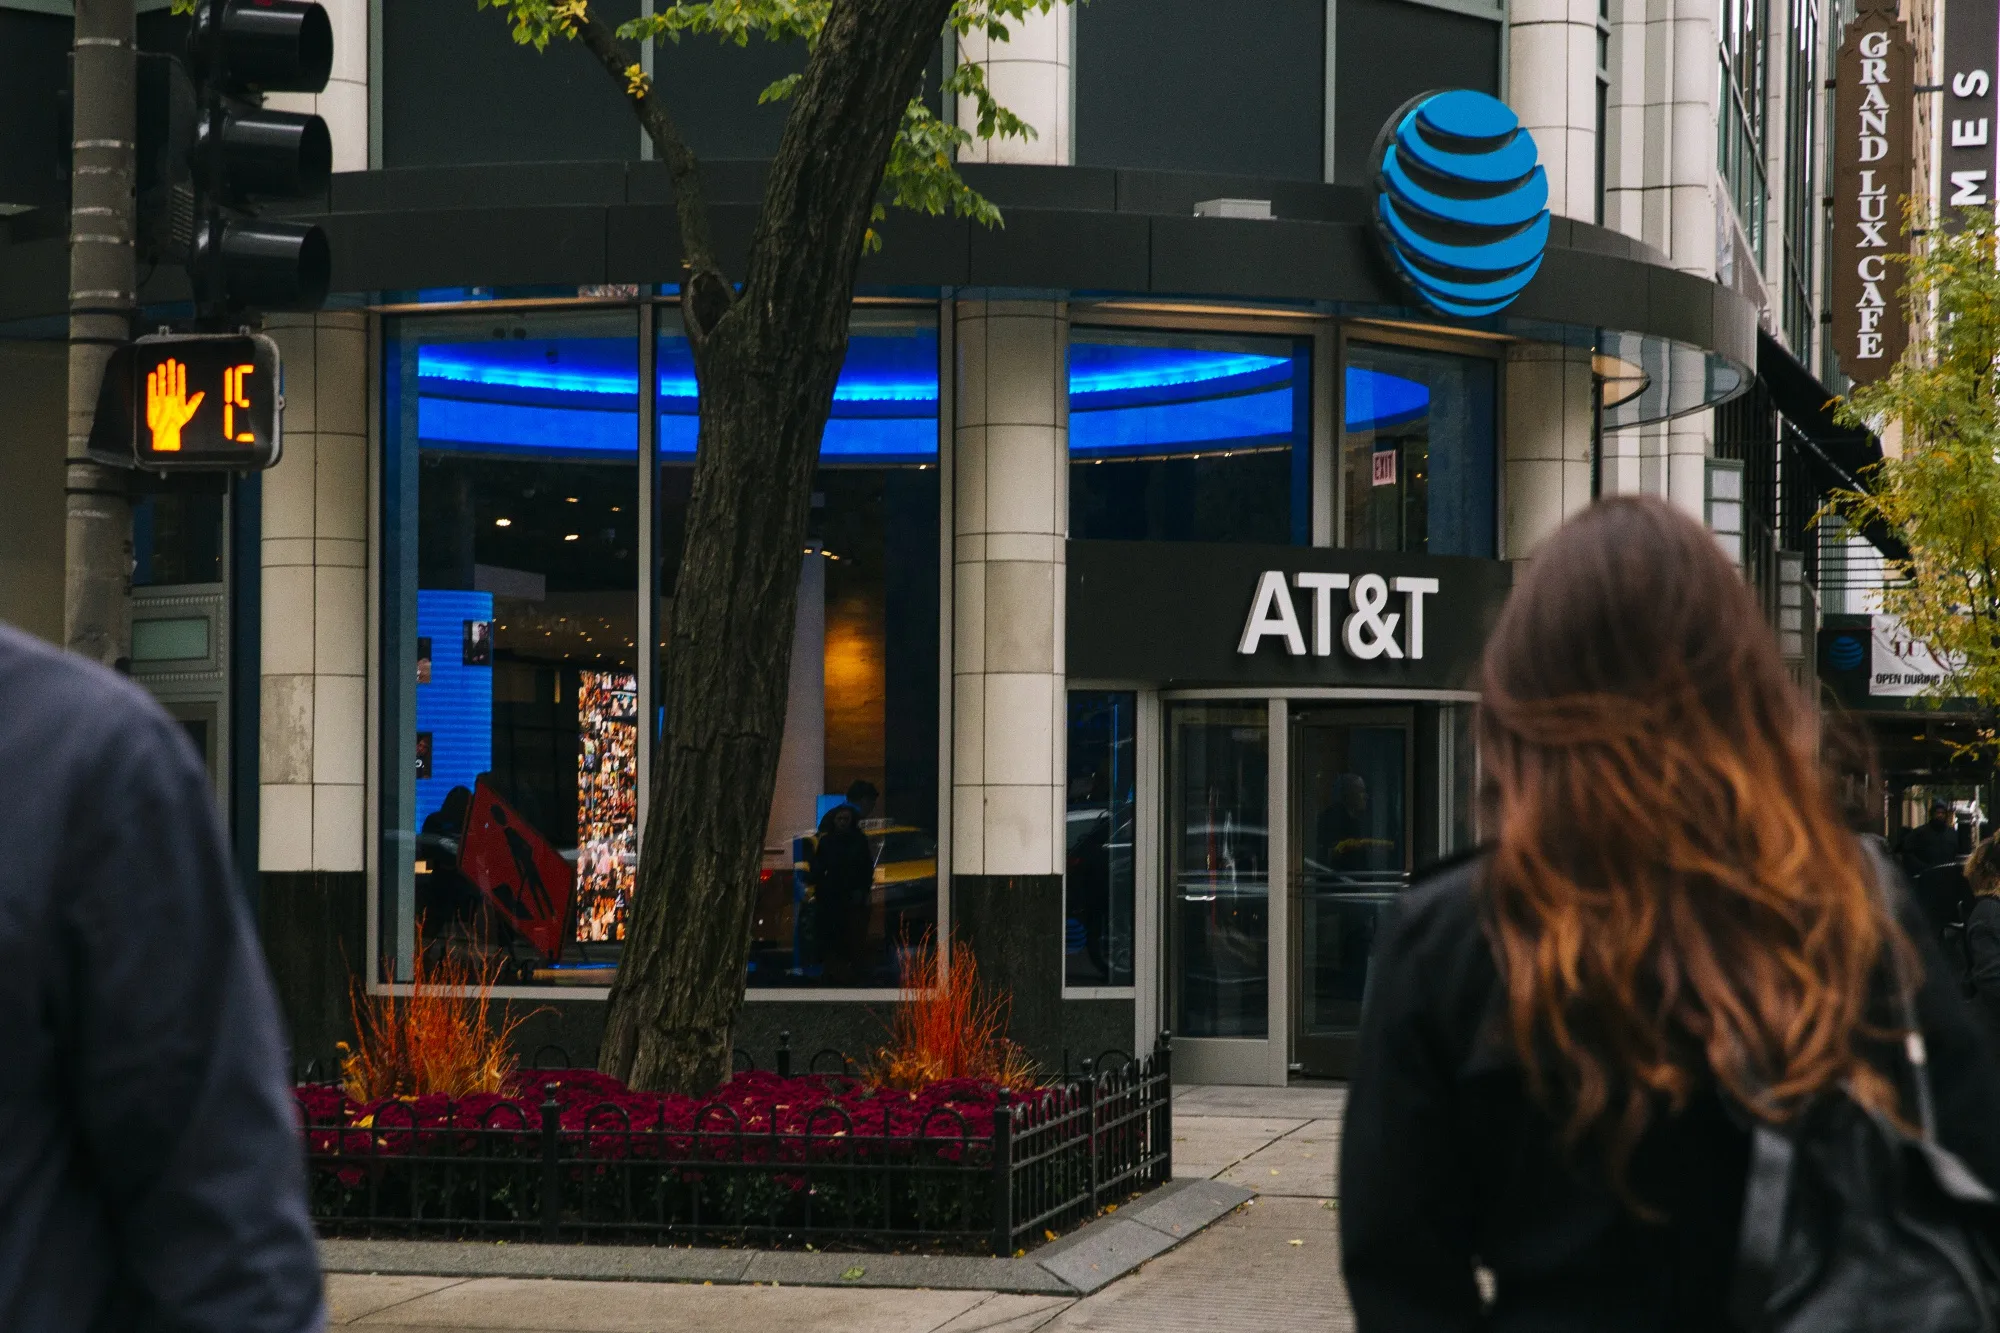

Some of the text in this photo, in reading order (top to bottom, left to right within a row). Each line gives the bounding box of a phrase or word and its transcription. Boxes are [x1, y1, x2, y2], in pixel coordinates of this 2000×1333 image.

[1951, 69, 1990, 206] MES
[1856, 31, 1891, 359] GRAND LUX CAFE
[1375, 453, 1394, 481] EXIT
[1237, 570, 1439, 660] AT&T
[1875, 673, 1901, 685] OPEN
[1903, 673, 1941, 685] DURING
